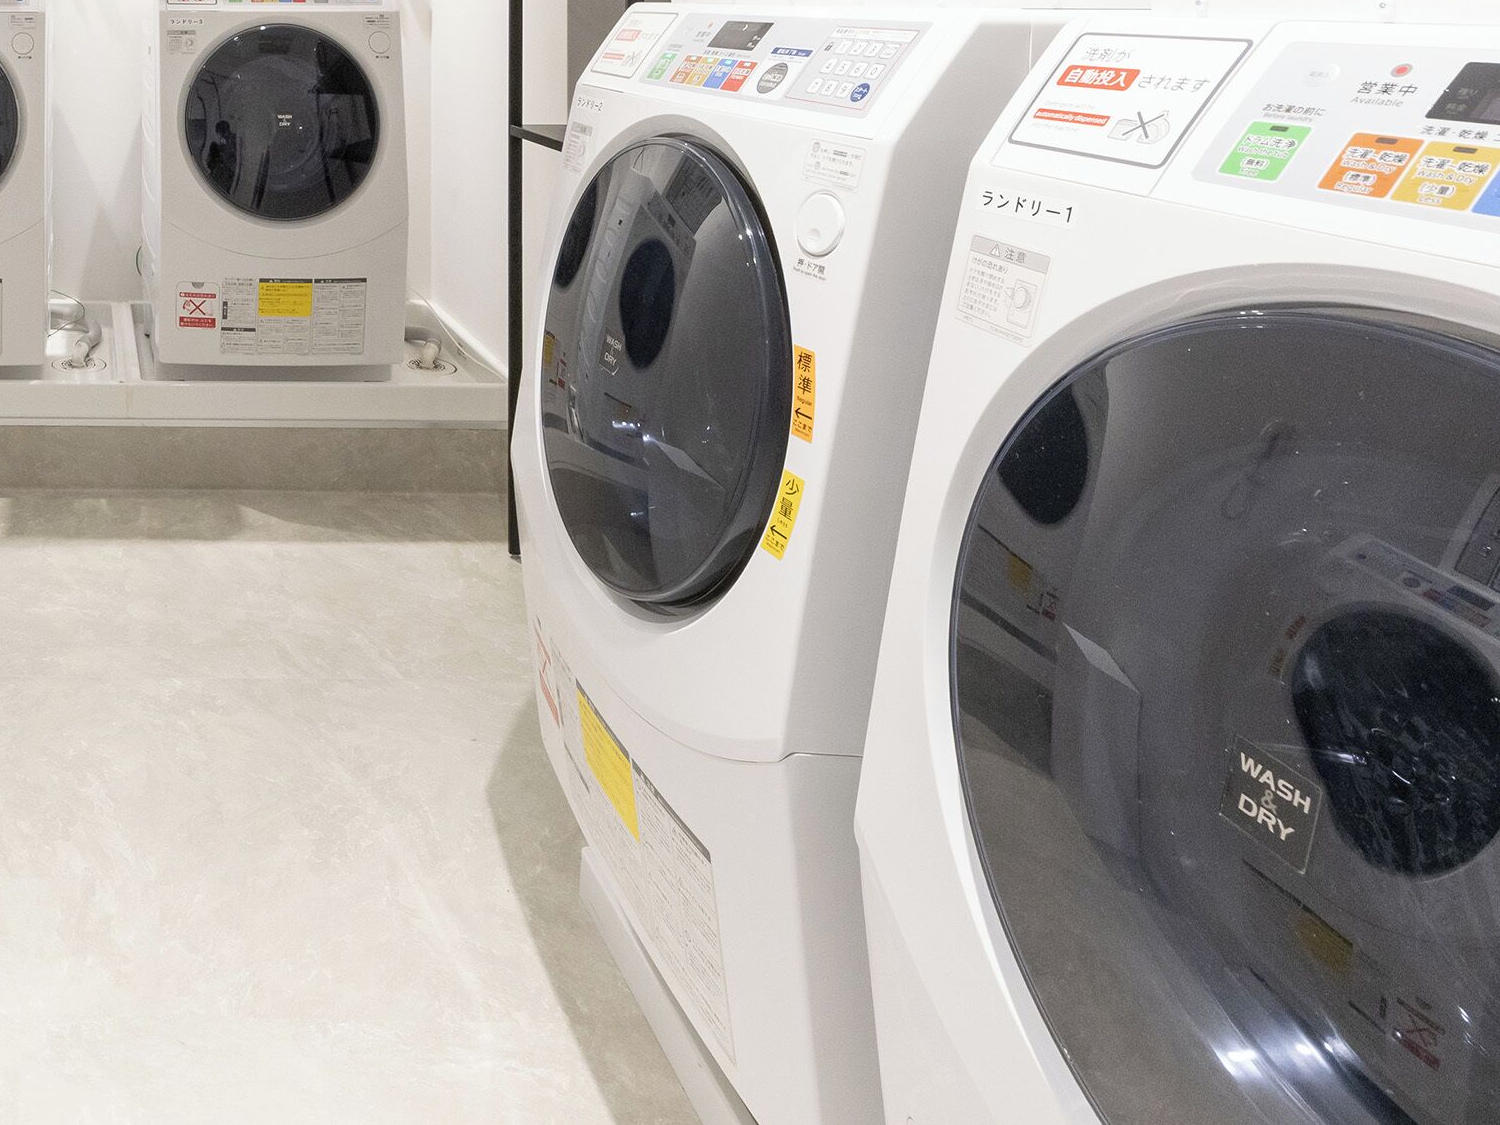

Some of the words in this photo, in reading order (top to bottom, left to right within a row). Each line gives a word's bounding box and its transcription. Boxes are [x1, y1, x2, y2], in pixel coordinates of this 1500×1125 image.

[1065, 68, 1128, 88] 自動投入
[1138, 74, 1211, 93] されます
[1357, 81, 1419, 97] 営業中
[1263, 103, 1327, 116] お洗濯の前に
[1351, 96, 1404, 108] Available
[1036, 110, 1074, 122] automatically
[1074, 115, 1108, 125] dispensed
[1342, 159, 1367, 169] Wash
[1417, 169, 1444, 180] Wash
[1455, 173, 1475, 185] Dry
[1335, 181, 1372, 194] Regular
[981, 190, 1074, 225] ランドリー1
[1418, 195, 1441, 205] Less
[1004, 247, 1027, 264] 注意
[606, 335, 622, 352] WASH
[604, 352, 617, 366] DRY
[796, 351, 813, 396] 標準
[793, 418, 813, 432] ここまで
[778, 477, 800, 522] 少量
[765, 533, 785, 551] ここまで
[1241, 752, 1311, 814] WASH
[1261, 789, 1278, 816] &
[1238, 793, 1295, 841] DRY
